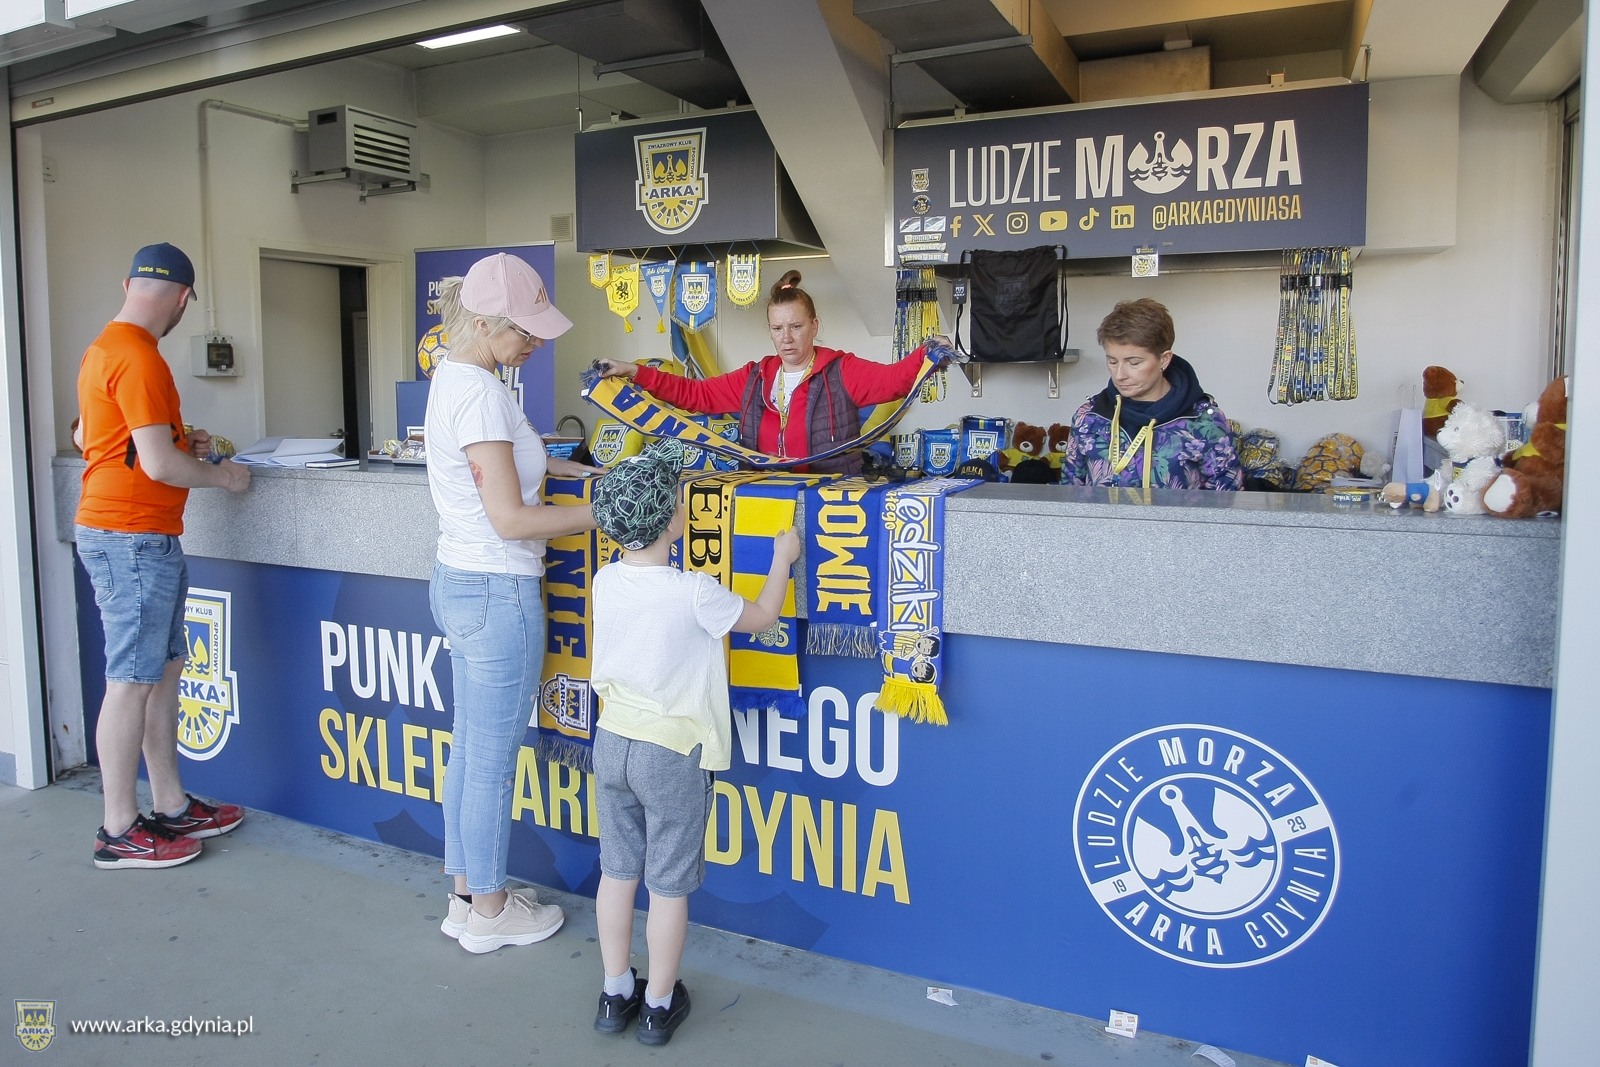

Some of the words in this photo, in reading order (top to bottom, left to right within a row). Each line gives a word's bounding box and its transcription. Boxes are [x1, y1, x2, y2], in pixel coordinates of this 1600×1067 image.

[950, 140, 1061, 208] LUDZIE
[649, 185, 695, 200] ARKA
[1152, 194, 1302, 231] @ARKAGDYNIASA
[960, 465, 984, 477] ARKA
[600, 531, 610, 562] STA
[195, 606, 213, 616] KLUB
[320, 620, 451, 711] PUNK
[178, 680, 221, 704] RKA
[559, 682, 568, 718] ARKA
[1087, 756, 1144, 870] LUDZIE
[1157, 736, 1297, 808] MORZA
[1286, 815, 1307, 834] 29
[704, 779, 911, 905] DYNIA
[1112, 878, 1128, 895] 19
[1124, 900, 1224, 956] ARKA
[1244, 847, 1327, 950] GDYNIA
